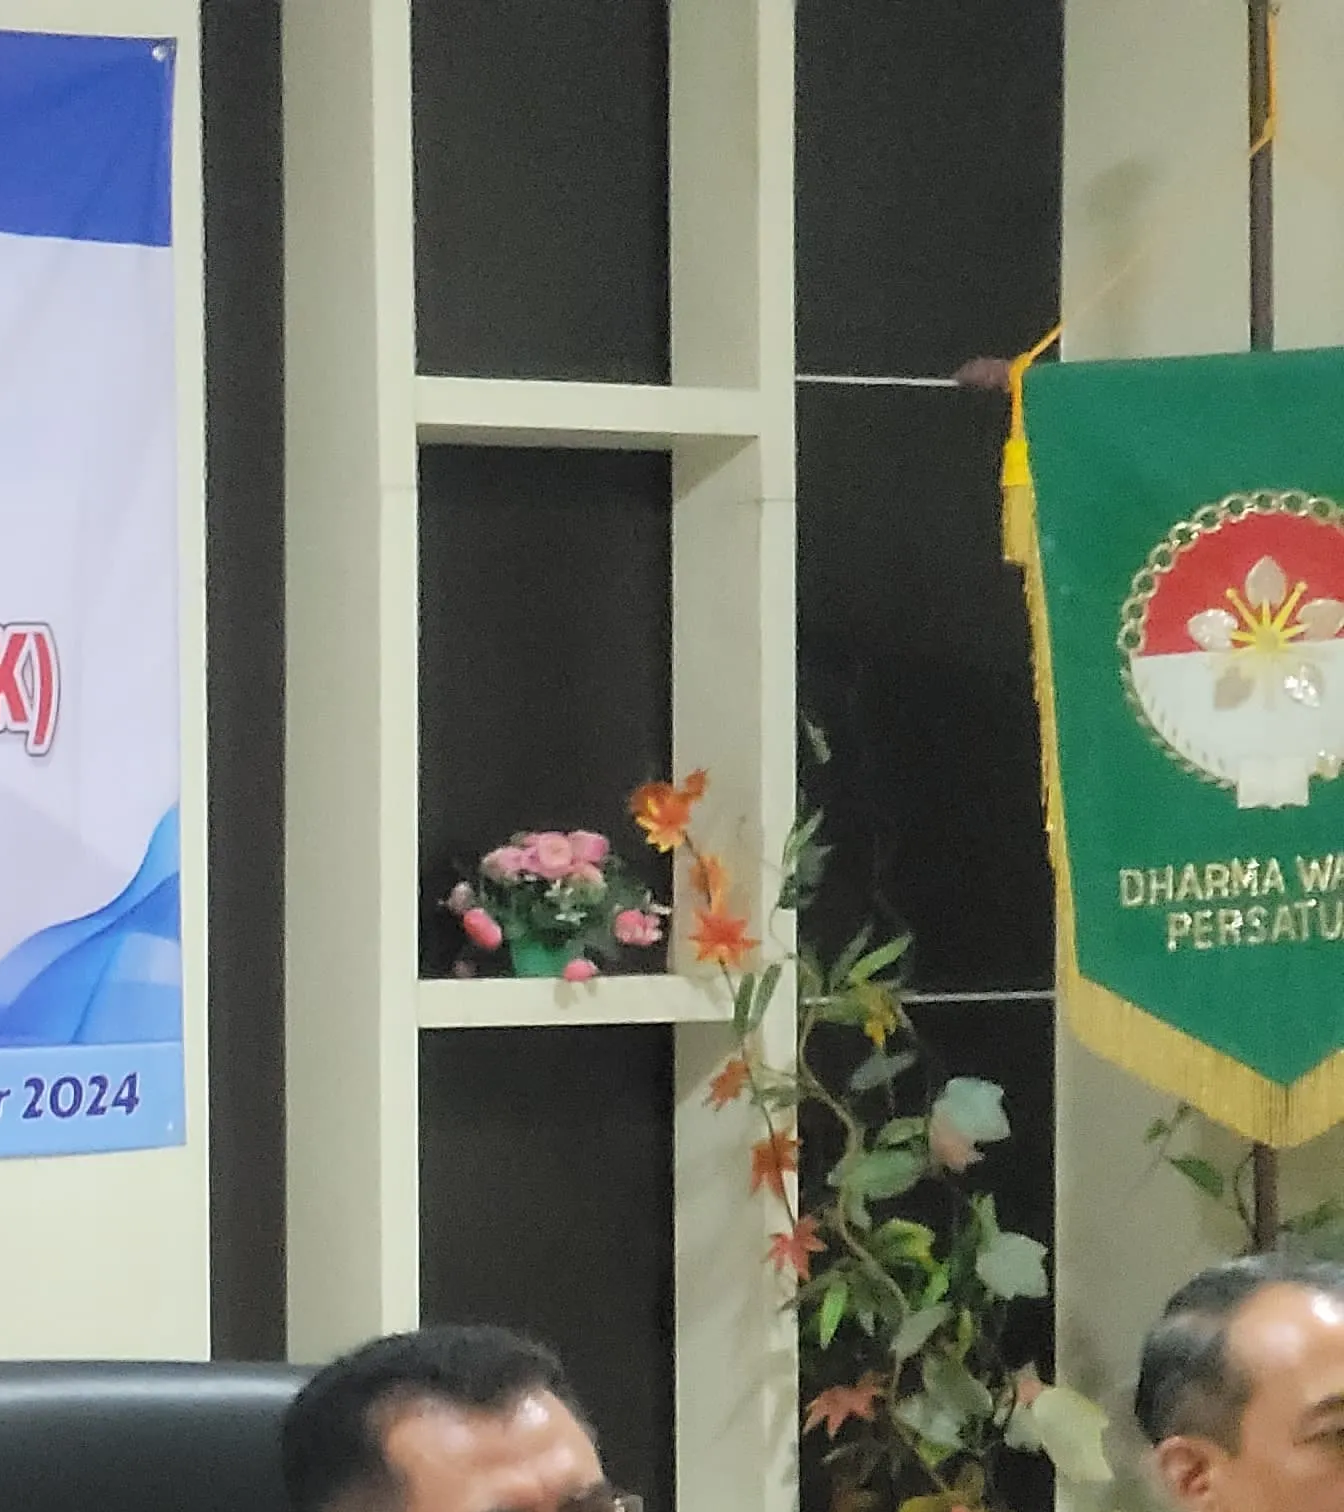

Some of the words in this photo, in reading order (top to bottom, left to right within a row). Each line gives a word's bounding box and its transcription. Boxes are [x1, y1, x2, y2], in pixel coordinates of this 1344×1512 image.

[1119, 857, 1285, 906] DHARMA
[1167, 898, 1344, 953] PERSATU
[21, 1073, 141, 1122] 2024
